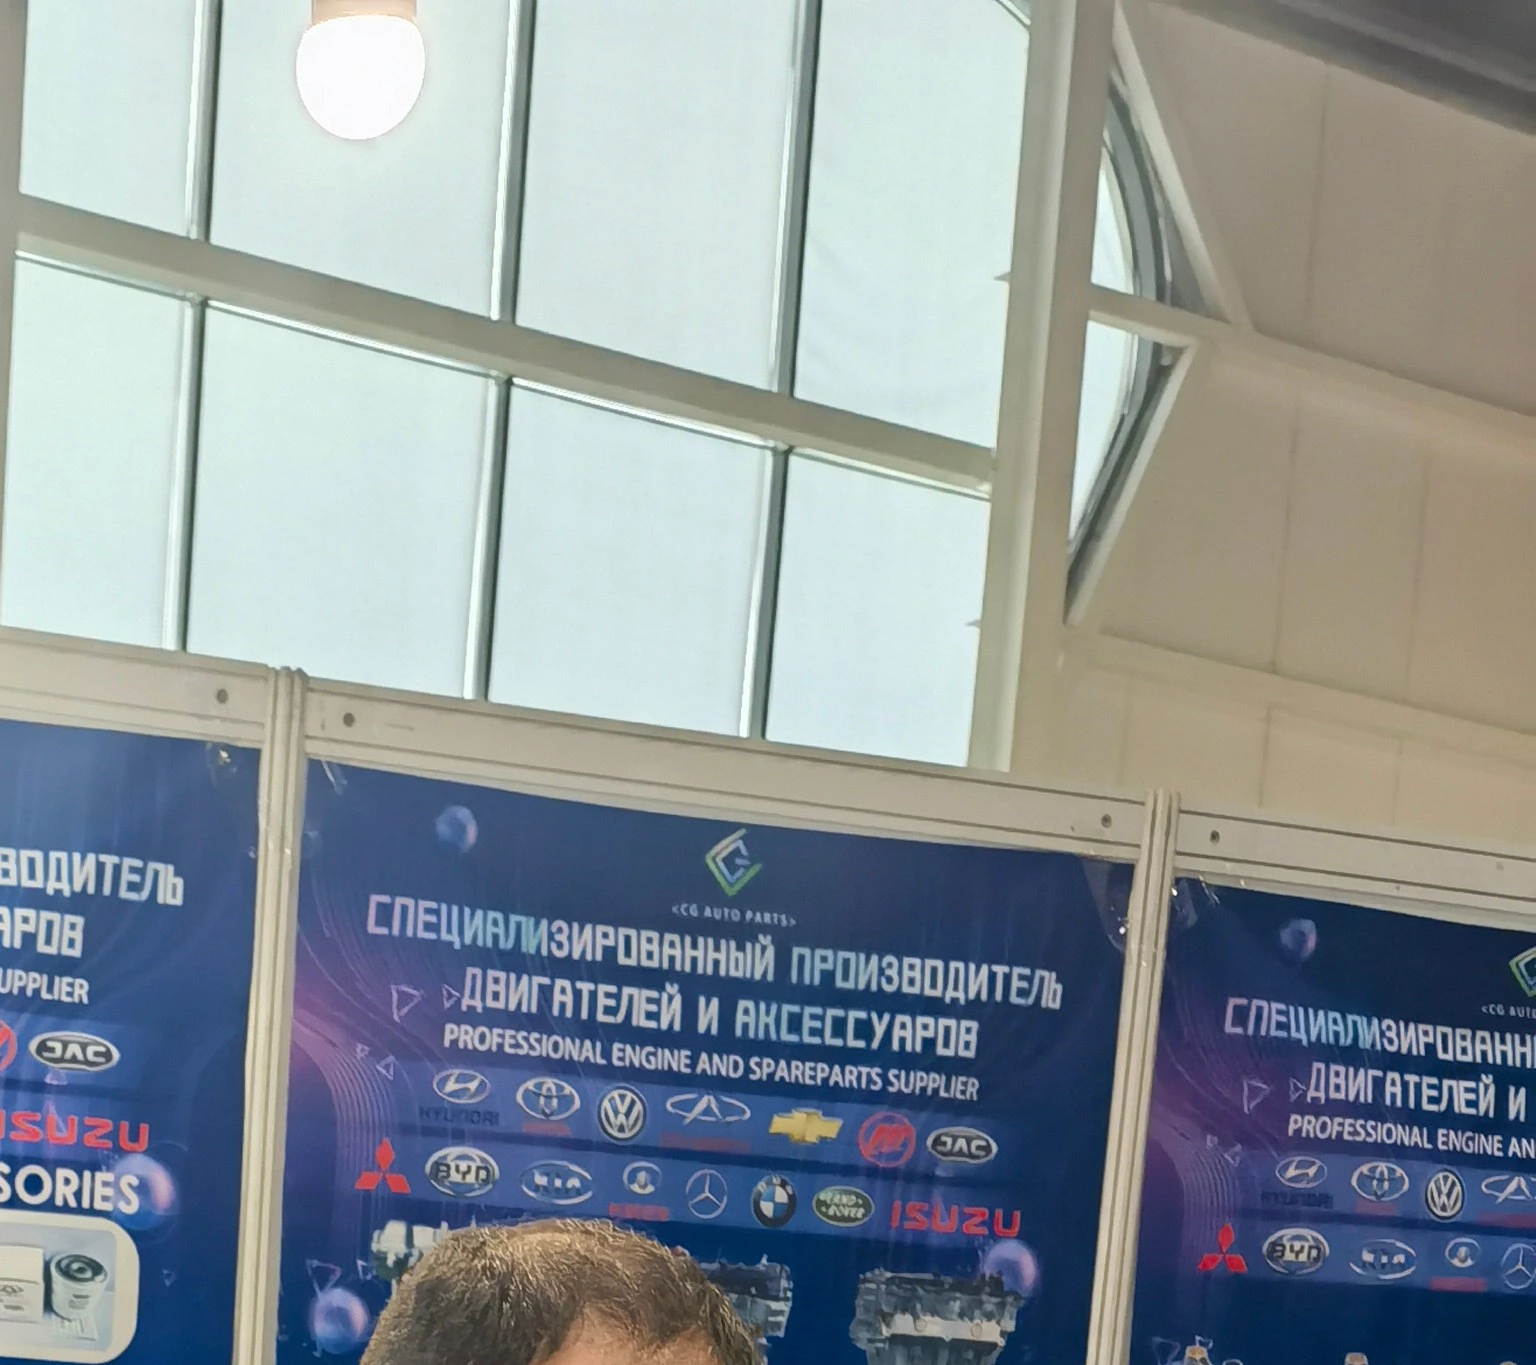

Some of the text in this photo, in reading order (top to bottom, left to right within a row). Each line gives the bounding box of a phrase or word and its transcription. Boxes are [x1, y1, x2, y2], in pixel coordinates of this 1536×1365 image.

[703, 906, 740, 923] AUTO
[367, 894, 1063, 1011] СПЕЦИАЛИЗИРОВАННЫЙ ПРОИЗВОДИТЕЛЬ
[461, 967, 979, 1059] ДВИГАТЕЛЕЙ И АКСЕССУАРОВ
[1224, 997, 1536, 1068] СПЕЦИАЛИЗИРОВАНН
[42, 1041, 106, 1063] JAC
[443, 1023, 979, 1101] PROFESSIONAL ENGINE AND SPAREPARTS SUPPLIER
[1306, 1062, 1526, 1122] ДВИГАТЕЛЕЙ И
[939, 1136, 987, 1154] JAC
[1288, 1114, 1536, 1159] PROFESSIONAL ENGINE AN
[434, 1162, 492, 1185] BYD
[891, 1200, 1021, 1238] ISUZU
